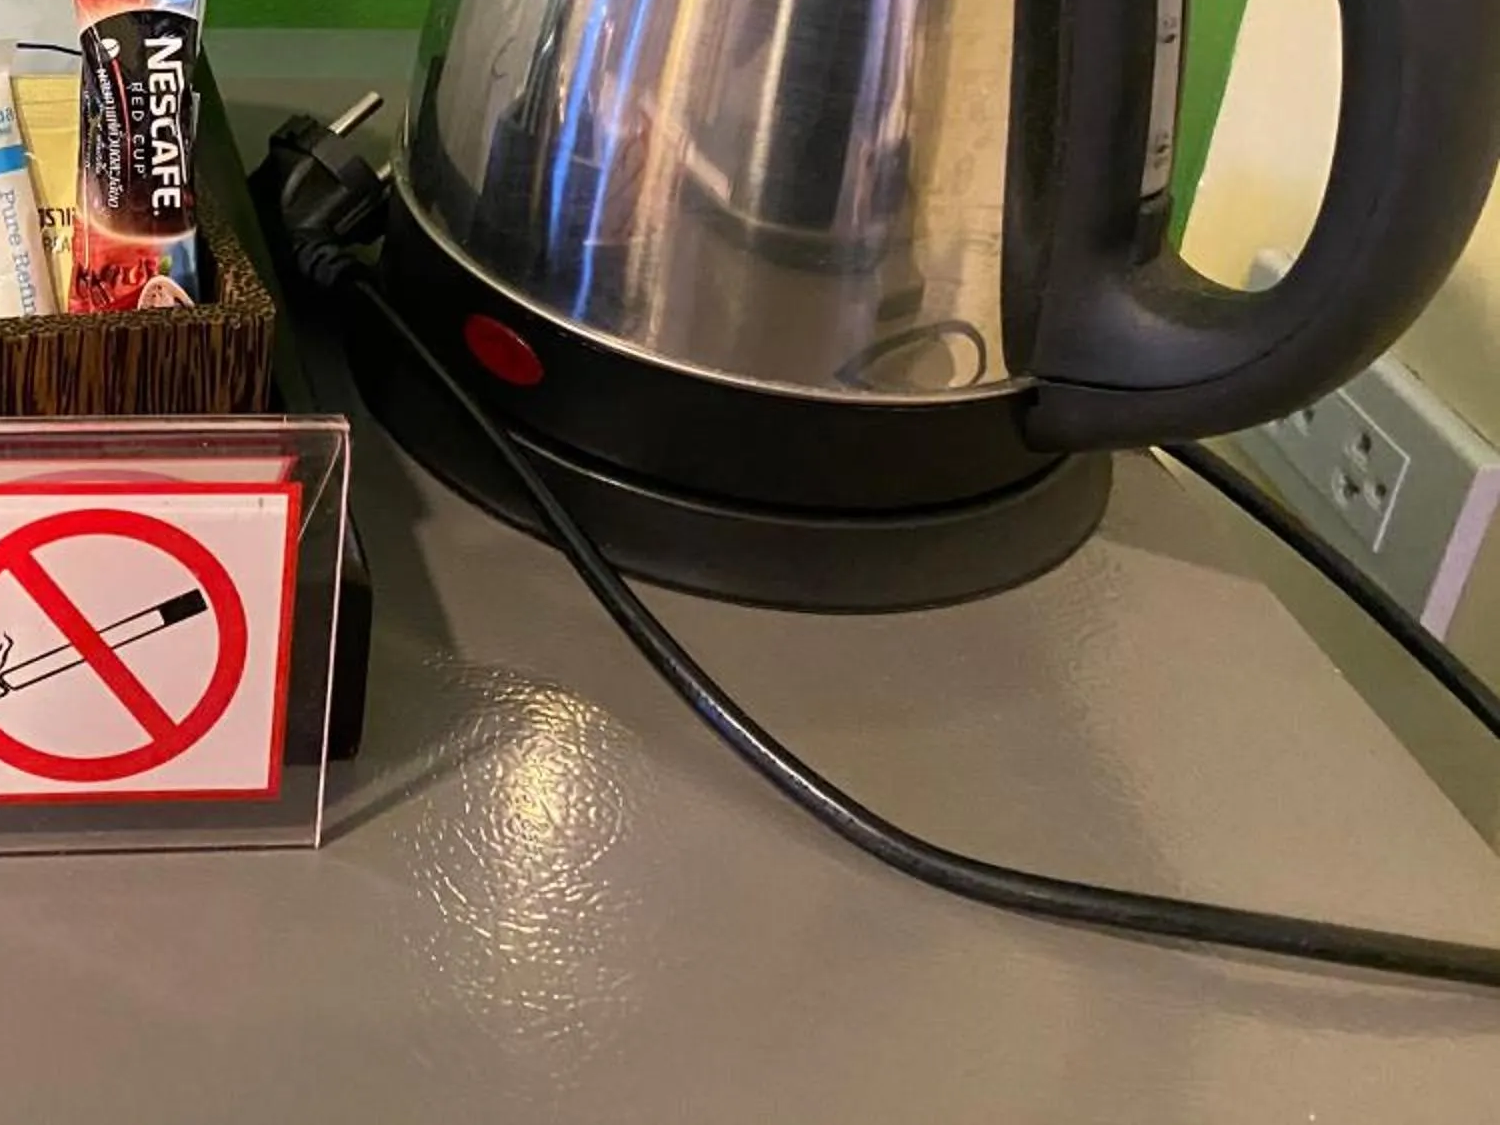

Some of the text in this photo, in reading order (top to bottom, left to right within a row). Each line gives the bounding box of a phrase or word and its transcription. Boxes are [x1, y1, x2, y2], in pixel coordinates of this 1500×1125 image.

[130, 81, 146, 175] RED CUP
[0, 187, 22, 246] Pure
